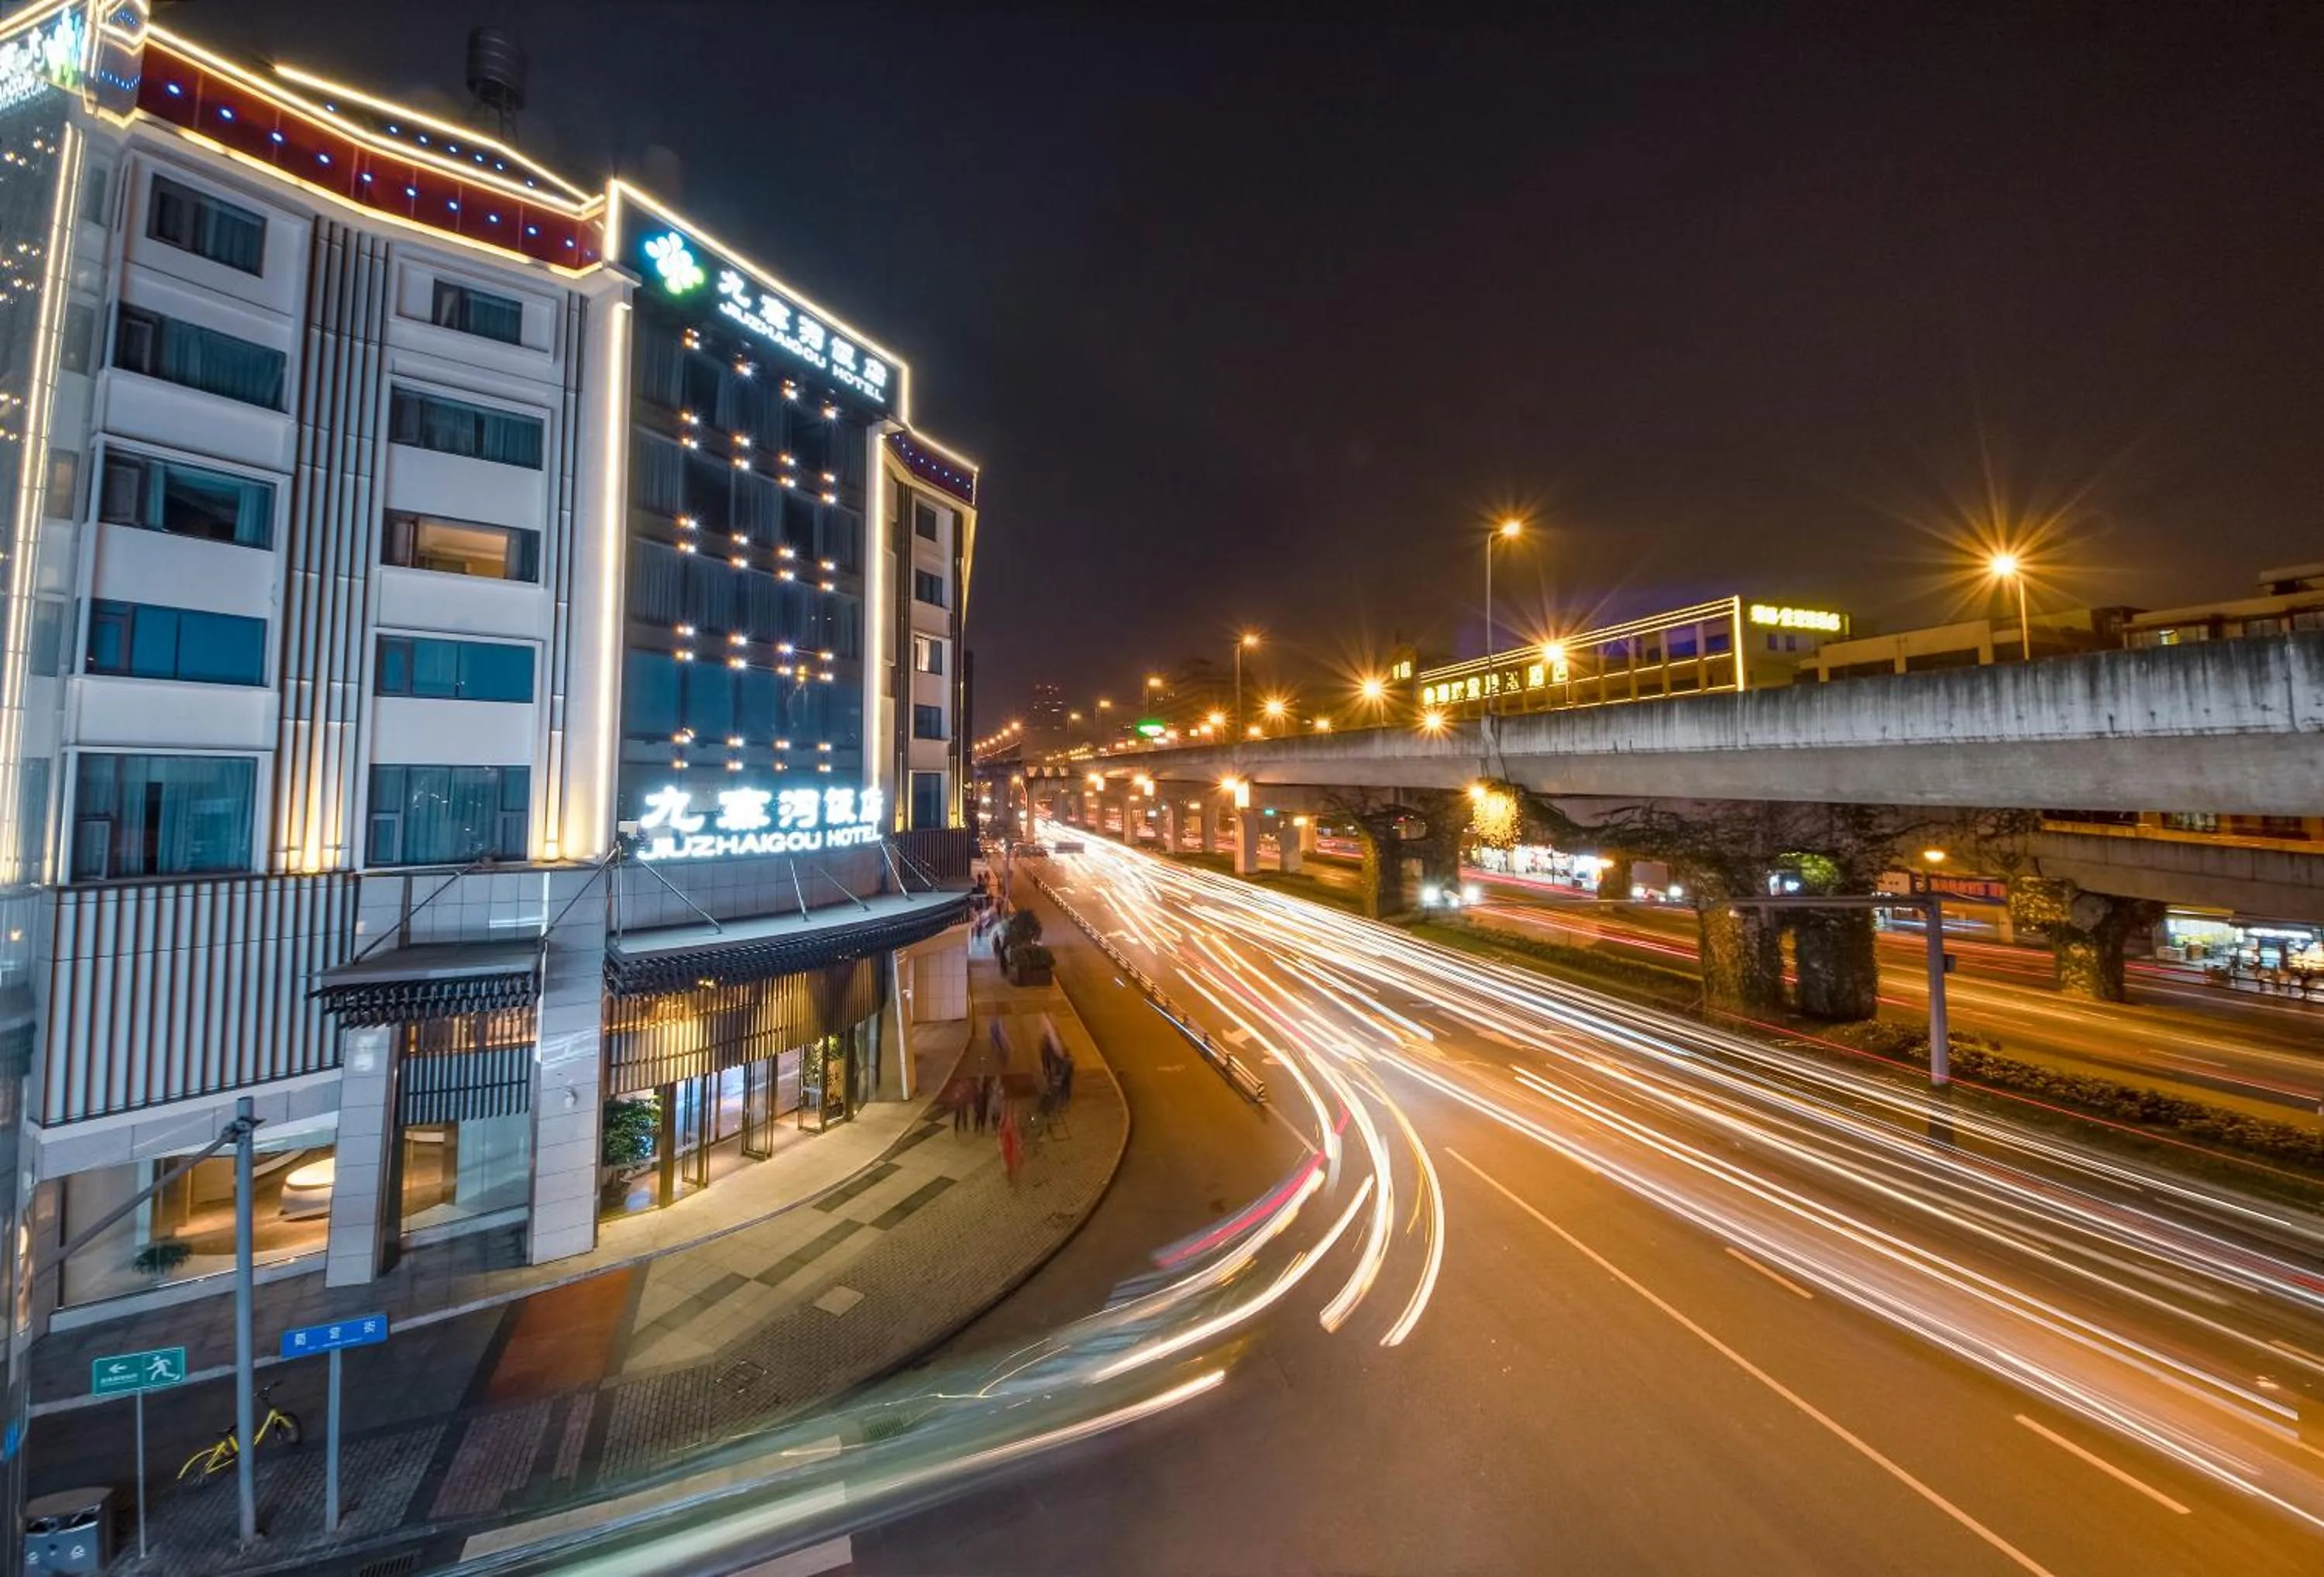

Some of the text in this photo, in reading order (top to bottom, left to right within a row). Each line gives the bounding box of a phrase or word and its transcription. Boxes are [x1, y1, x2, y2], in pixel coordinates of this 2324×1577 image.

[717, 270, 887, 387] 九寨沟饭店
[719, 301, 885, 403] JIUZHAIGOU HOTEL
[637, 826, 882, 861] JIUZHAIGOU HOTEL
[641, 785, 884, 831] 九寨沟饭店
